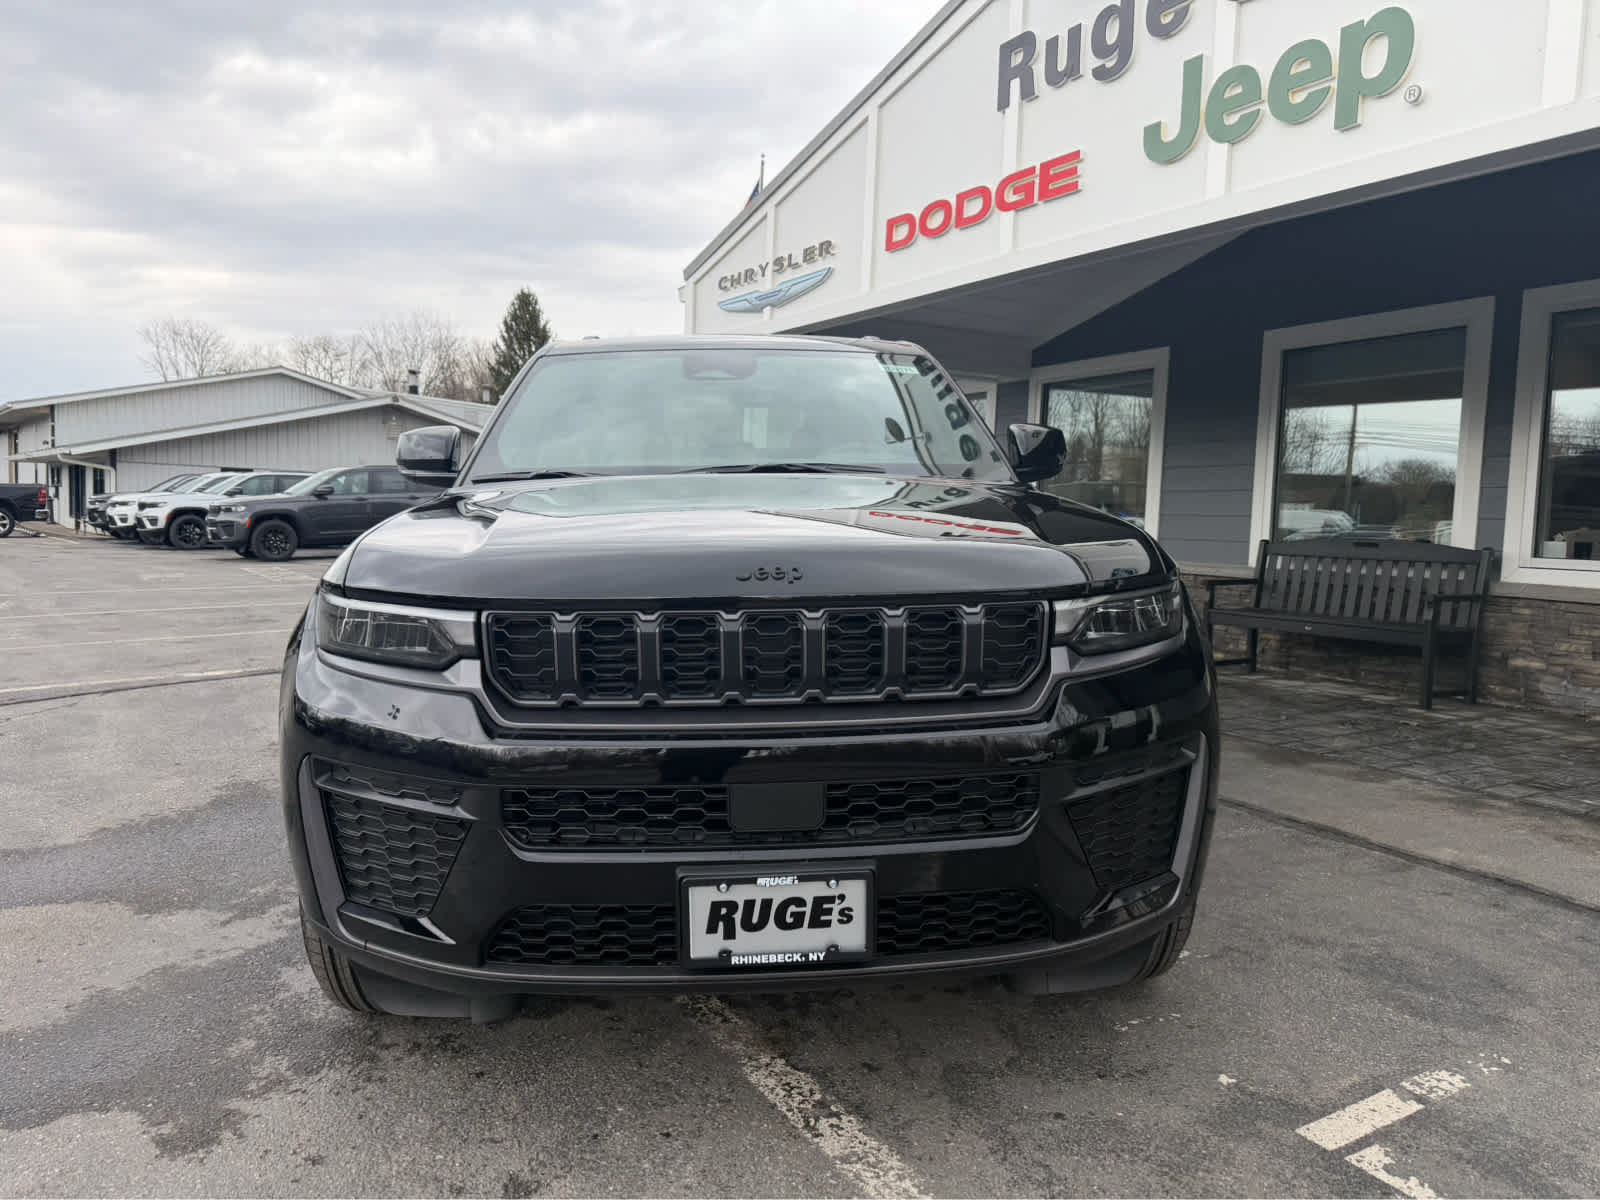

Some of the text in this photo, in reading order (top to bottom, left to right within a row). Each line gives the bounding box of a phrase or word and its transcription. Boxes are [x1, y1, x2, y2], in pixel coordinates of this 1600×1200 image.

[1143, 6, 1415, 165] Jeep
[885, 149, 1081, 252] DODGE
[718, 240, 834, 291] CHRYSLER
[735, 565, 804, 585] Jeep
[705, 893, 854, 940] RUGE's
[808, 951, 826, 961] NY
